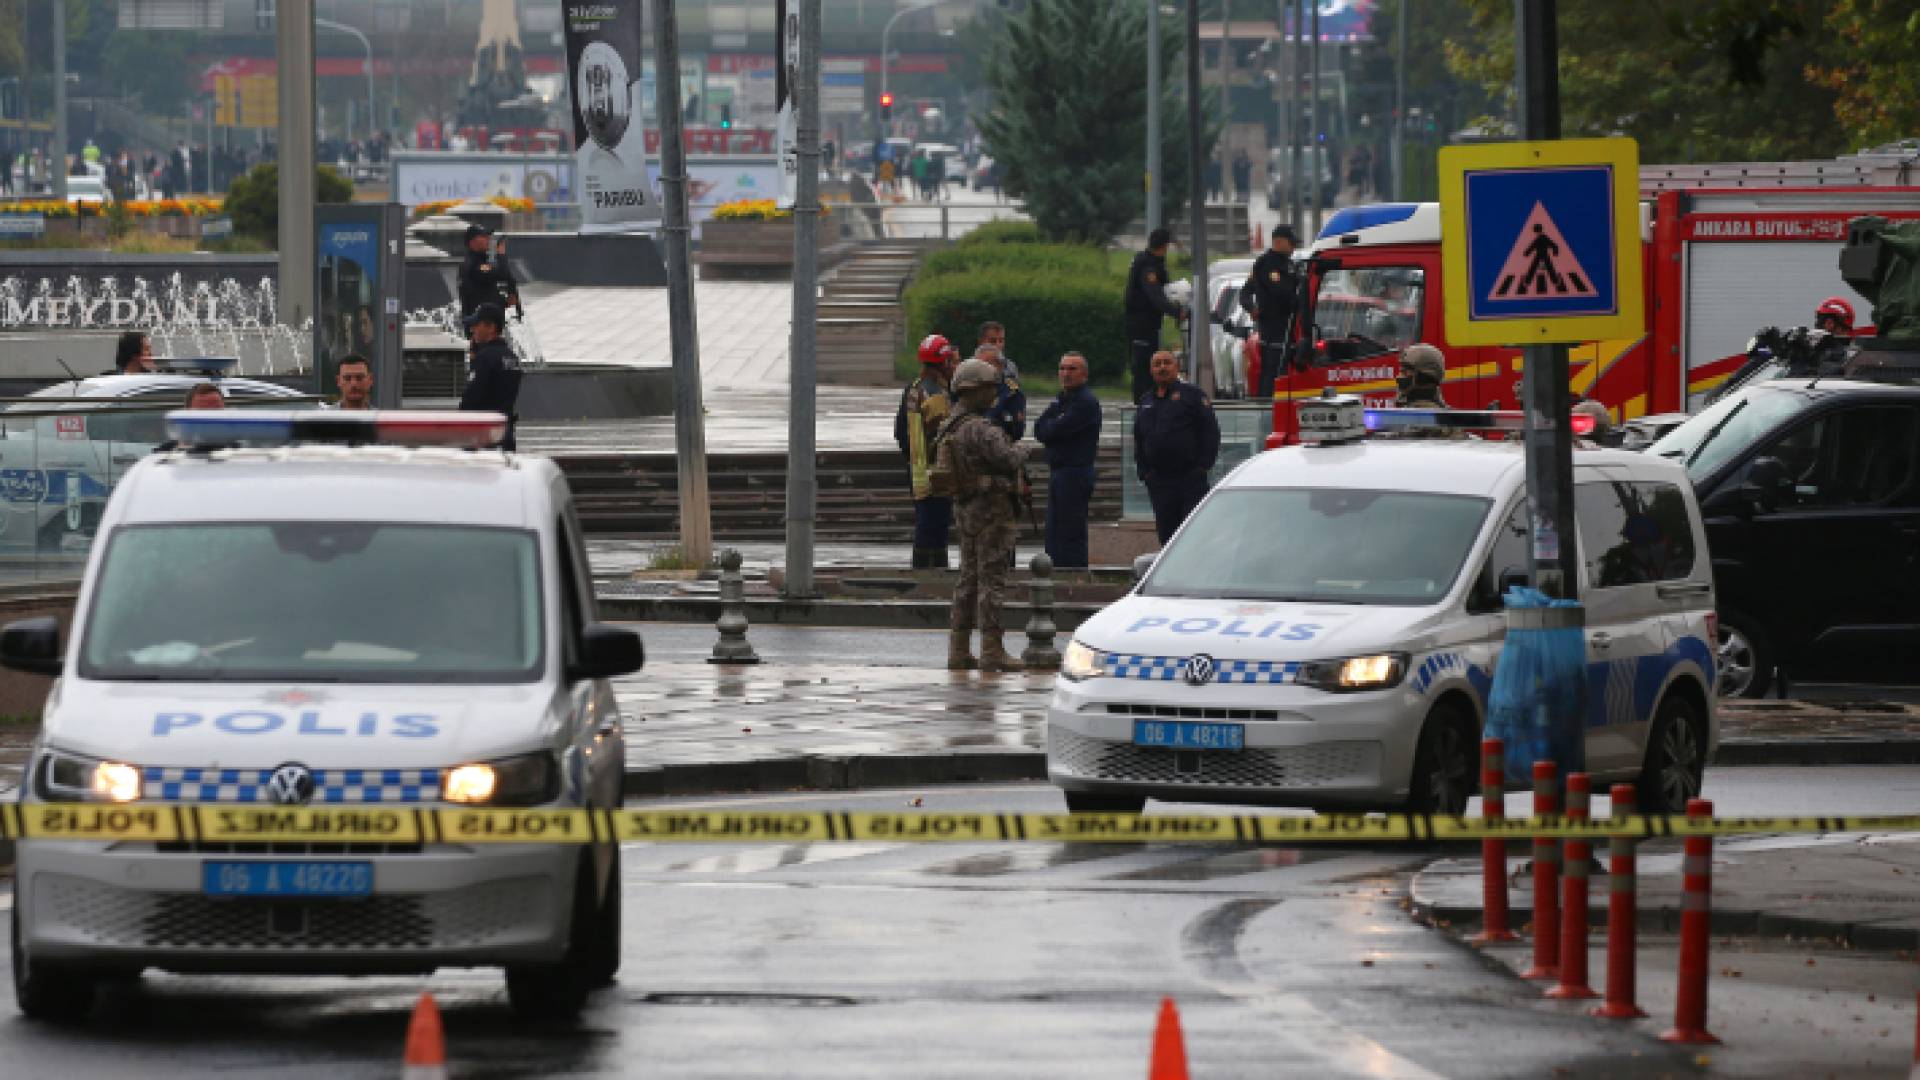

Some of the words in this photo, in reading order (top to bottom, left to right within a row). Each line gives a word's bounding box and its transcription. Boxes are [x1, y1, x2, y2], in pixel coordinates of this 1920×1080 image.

[1694, 219, 1752, 237] ANKARA
[1174, 722, 1184, 745] A
[266, 863, 283, 891] A
